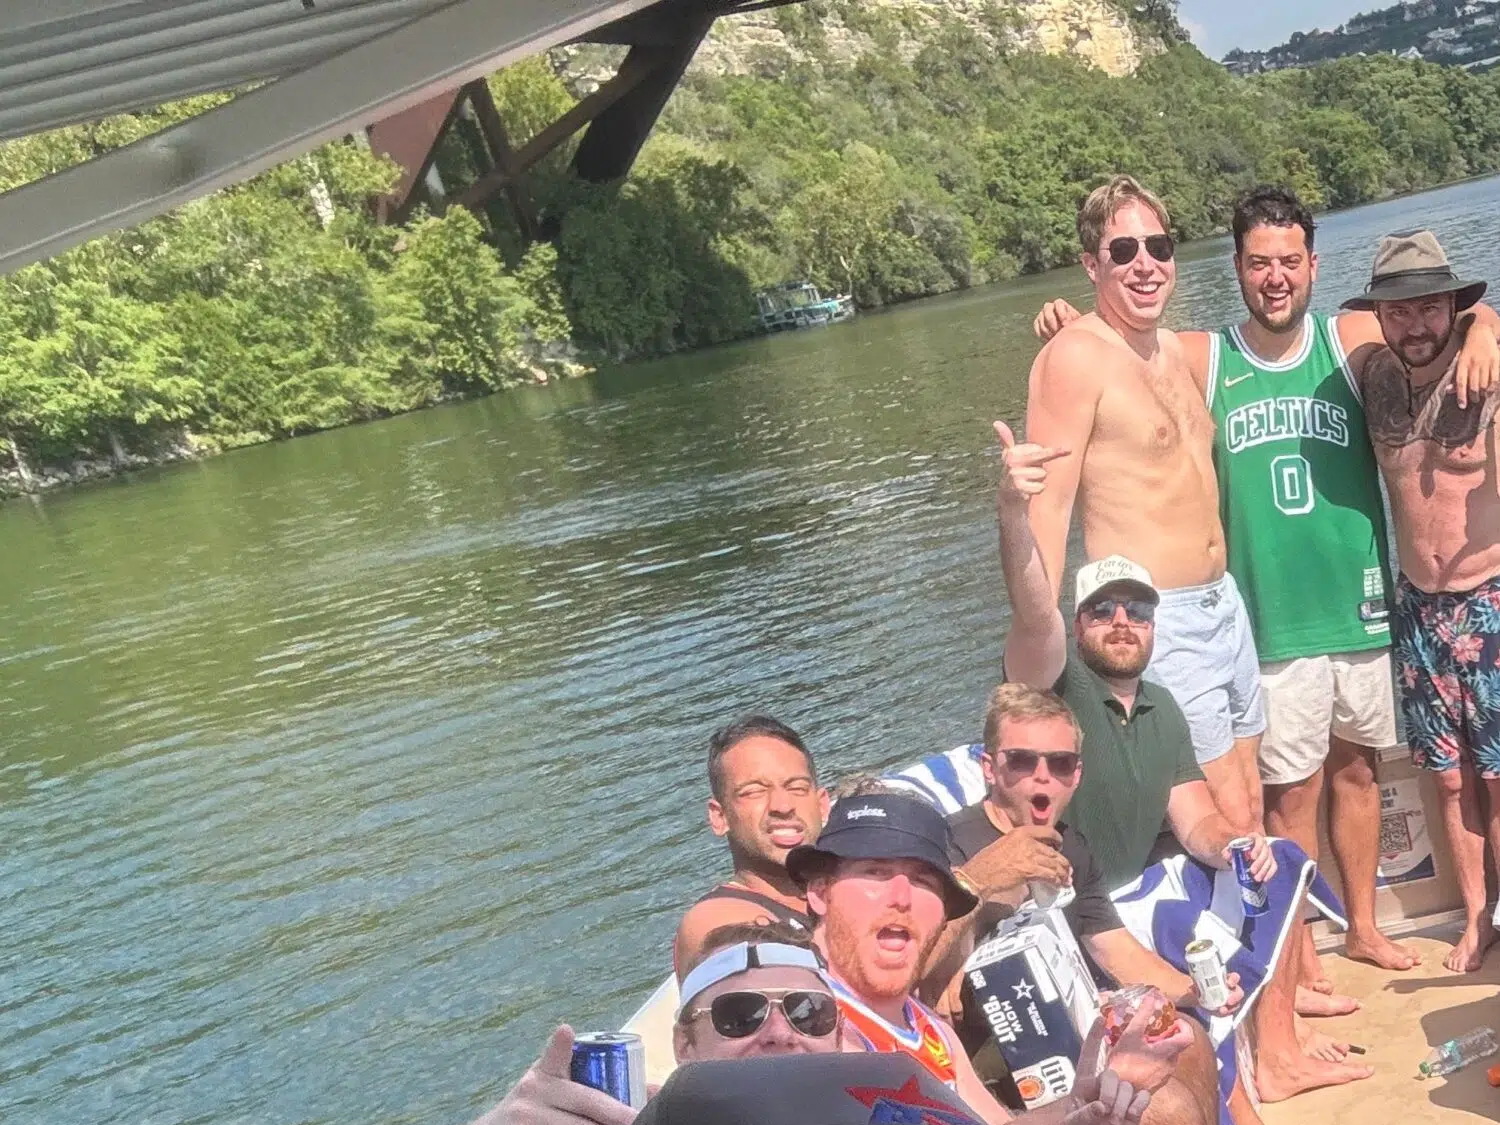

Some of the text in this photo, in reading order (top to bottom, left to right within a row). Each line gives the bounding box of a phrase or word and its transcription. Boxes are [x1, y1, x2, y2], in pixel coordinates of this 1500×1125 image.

[1226, 396, 1349, 453] CELTICS
[1271, 454, 1315, 515] 0
[982, 994, 1017, 1044] 'BOUT
[1001, 1000, 1024, 1032] HOW
